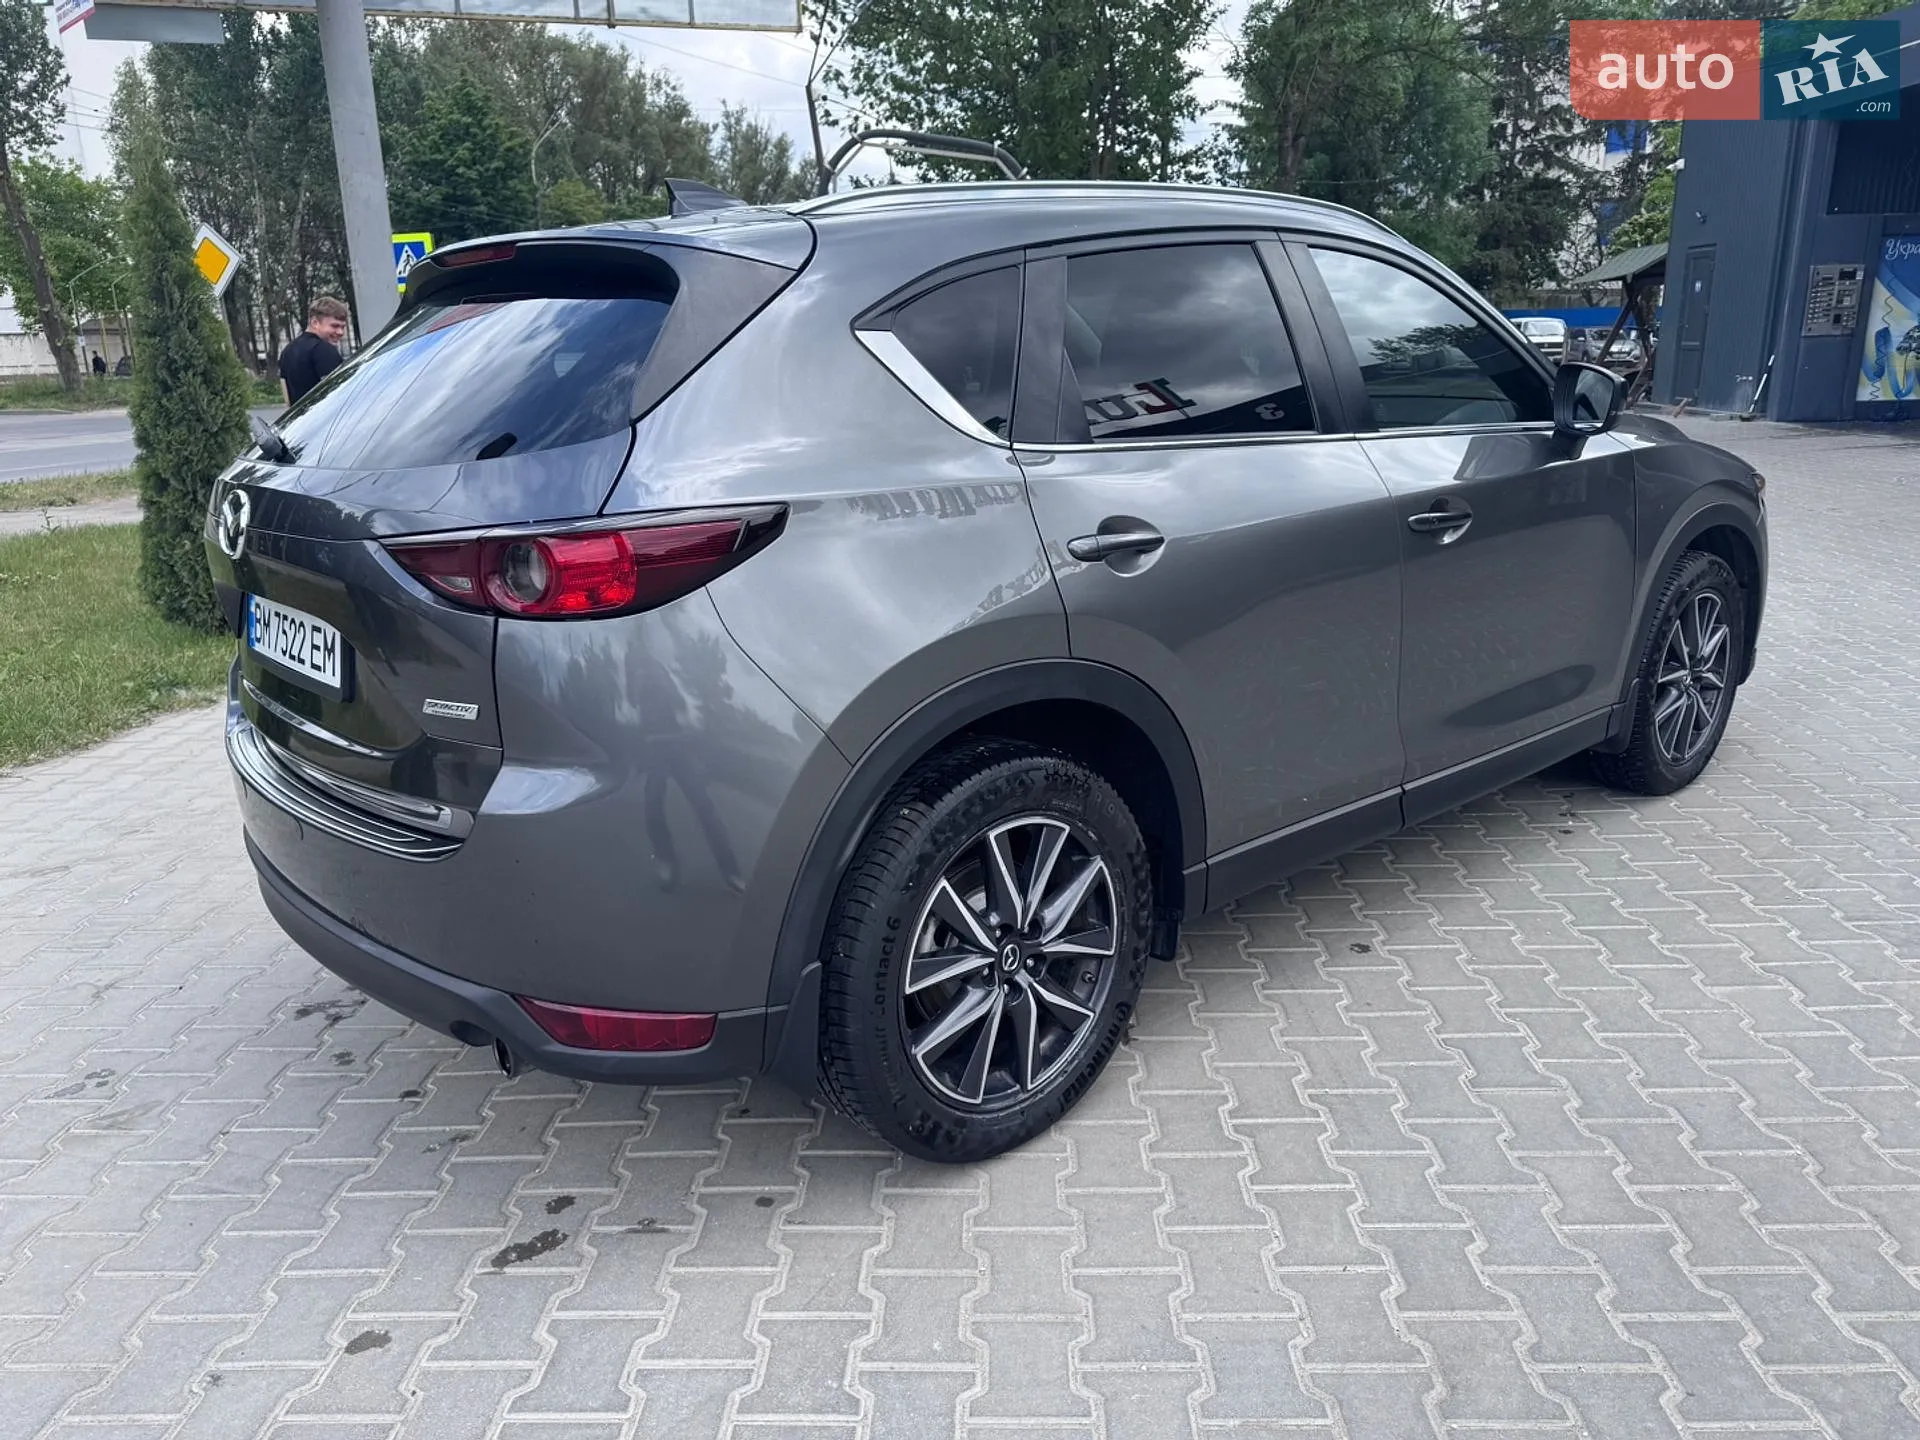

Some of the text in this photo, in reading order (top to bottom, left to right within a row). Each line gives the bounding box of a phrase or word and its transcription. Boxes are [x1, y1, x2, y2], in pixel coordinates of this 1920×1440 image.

[255, 602, 336, 677] BM 7522 EM
